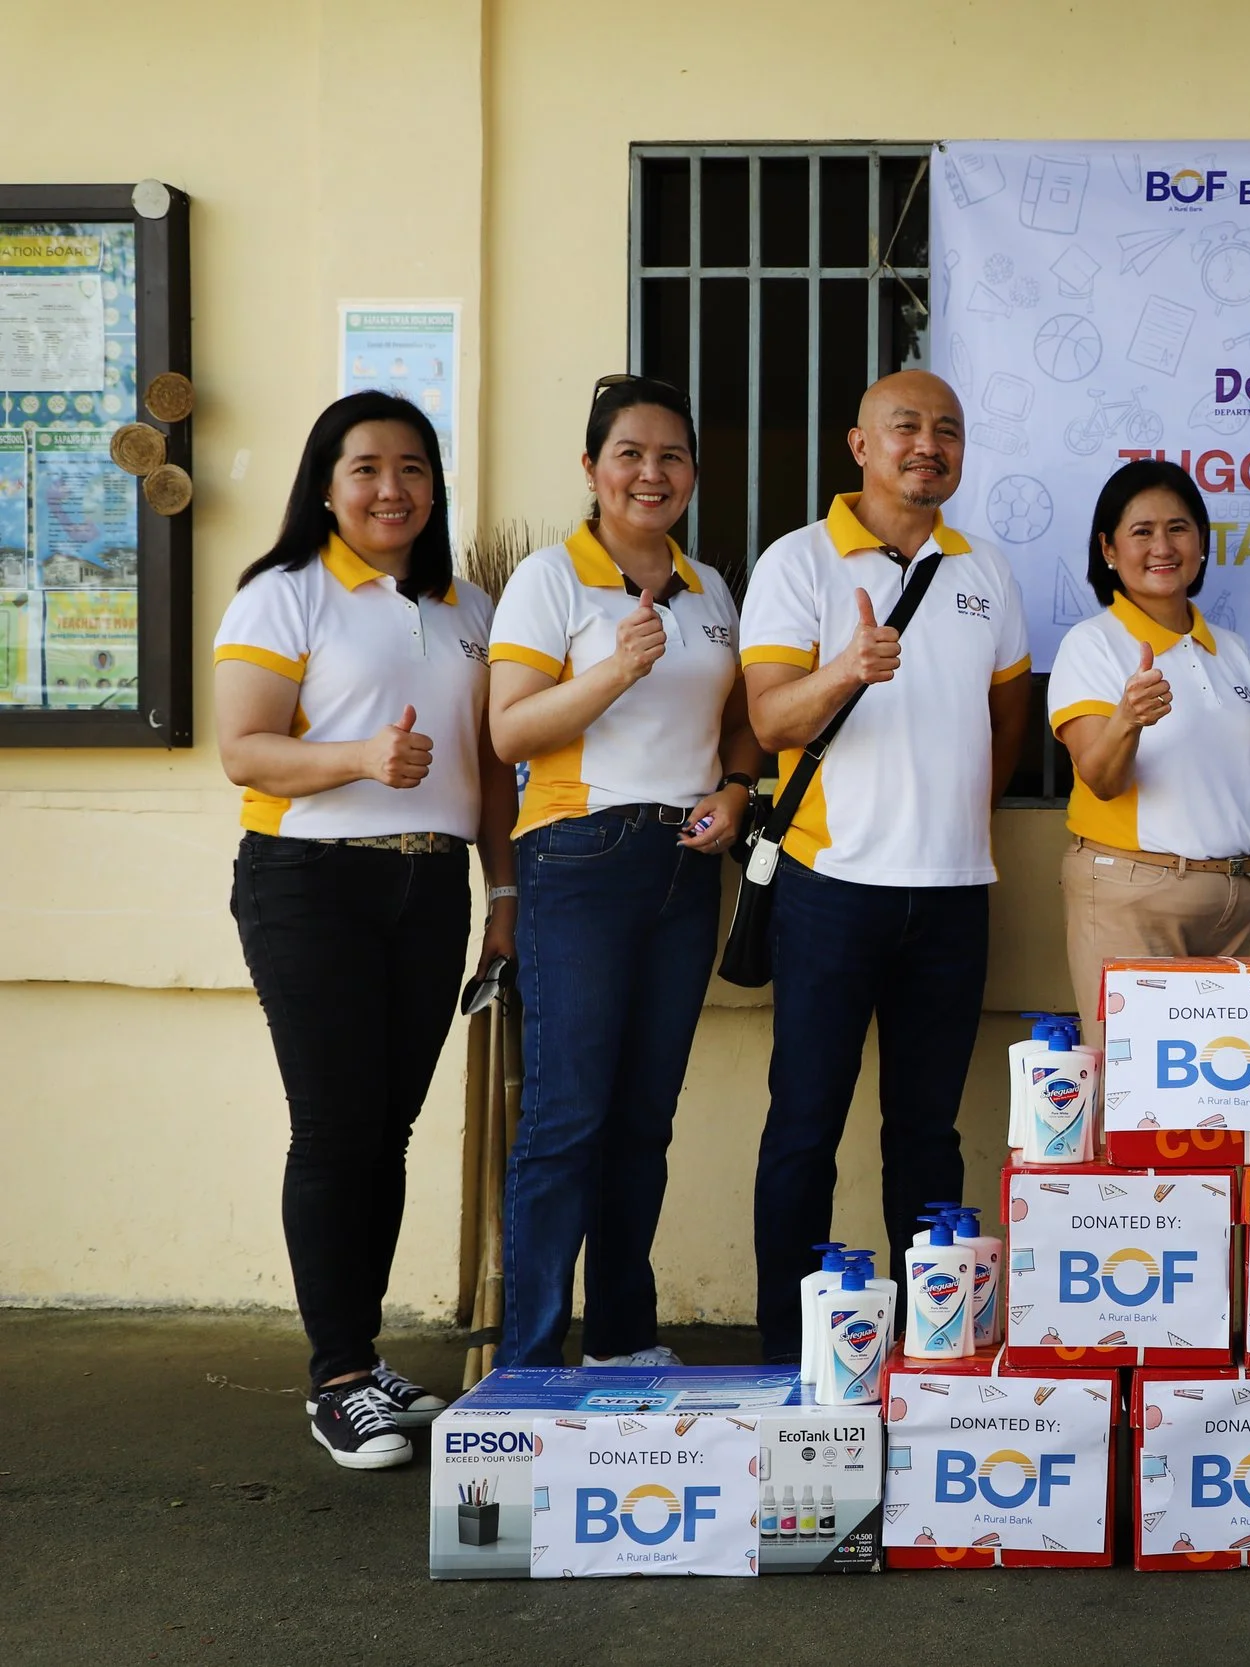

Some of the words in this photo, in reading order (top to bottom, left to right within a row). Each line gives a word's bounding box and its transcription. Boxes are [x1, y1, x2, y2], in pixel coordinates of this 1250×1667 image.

[1146, 169, 1228, 202] BOF
[956, 593, 990, 613] BOF
[1168, 1007, 1248, 1020] DONATED
[1041, 1083, 1081, 1099] Safeguard
[1197, 1096, 1205, 1105] A
[1207, 1096, 1231, 1106] Rural
[1071, 1215, 1151, 1229] DONATED
[1156, 1215, 1182, 1229] BY:
[1059, 1248, 1198, 1307] BOF
[920, 1278, 960, 1294] Safeguard
[1099, 1313, 1106, 1321] A
[1108, 1313, 1132, 1322] Rural
[1134, 1313, 1157, 1322] Bank
[839, 1324, 878, 1342] Safeguard
[950, 1417, 1030, 1431] DONATED
[1035, 1419, 1061, 1433] BY:
[445, 1431, 534, 1454] EPSON
[779, 1430, 830, 1443] EcoTank
[834, 1427, 865, 1442] L121
[445, 1456, 480, 1464] EXCEED
[589, 1450, 672, 1465] DONATED
[677, 1450, 704, 1465] BY:
[935, 1449, 1076, 1509] BOF
[576, 1484, 721, 1546] BOF
[974, 1514, 981, 1522] A
[983, 1515, 1007, 1524] Rural
[1009, 1515, 1033, 1525] Bank
[1230, 1517, 1238, 1525] A
[617, 1553, 624, 1561] A
[626, 1553, 651, 1561] Rural
[653, 1553, 678, 1562] Bank
